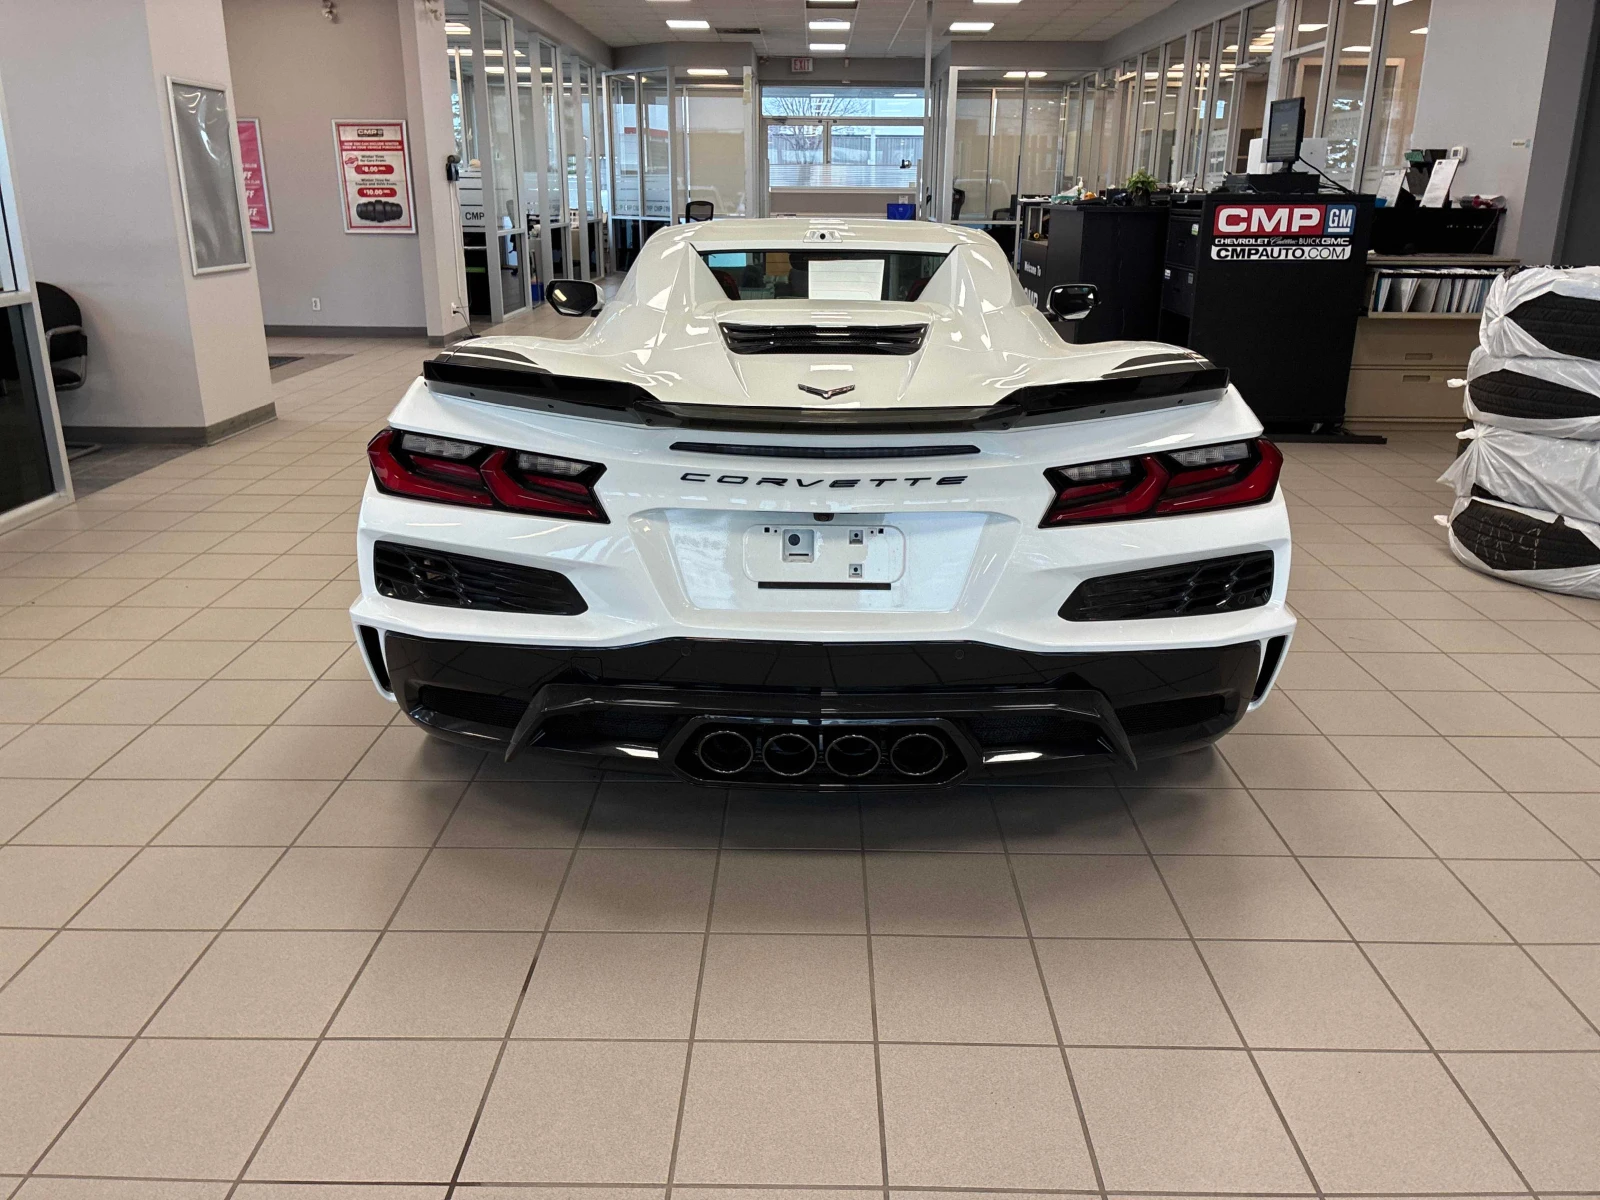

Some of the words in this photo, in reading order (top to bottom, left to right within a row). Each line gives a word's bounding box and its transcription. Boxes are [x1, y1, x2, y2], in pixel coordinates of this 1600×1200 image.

[793, 58, 810, 71] EXIT
[465, 211, 485, 221] CMP
[1218, 208, 1321, 233] CMP
[1328, 208, 1353, 228] GM
[1298, 237, 1321, 245] BUICK
[1321, 237, 1350, 245] GMC
[1216, 247, 1346, 259] CMPAUTO.COM
[680, 472, 969, 488] CORVETTE
